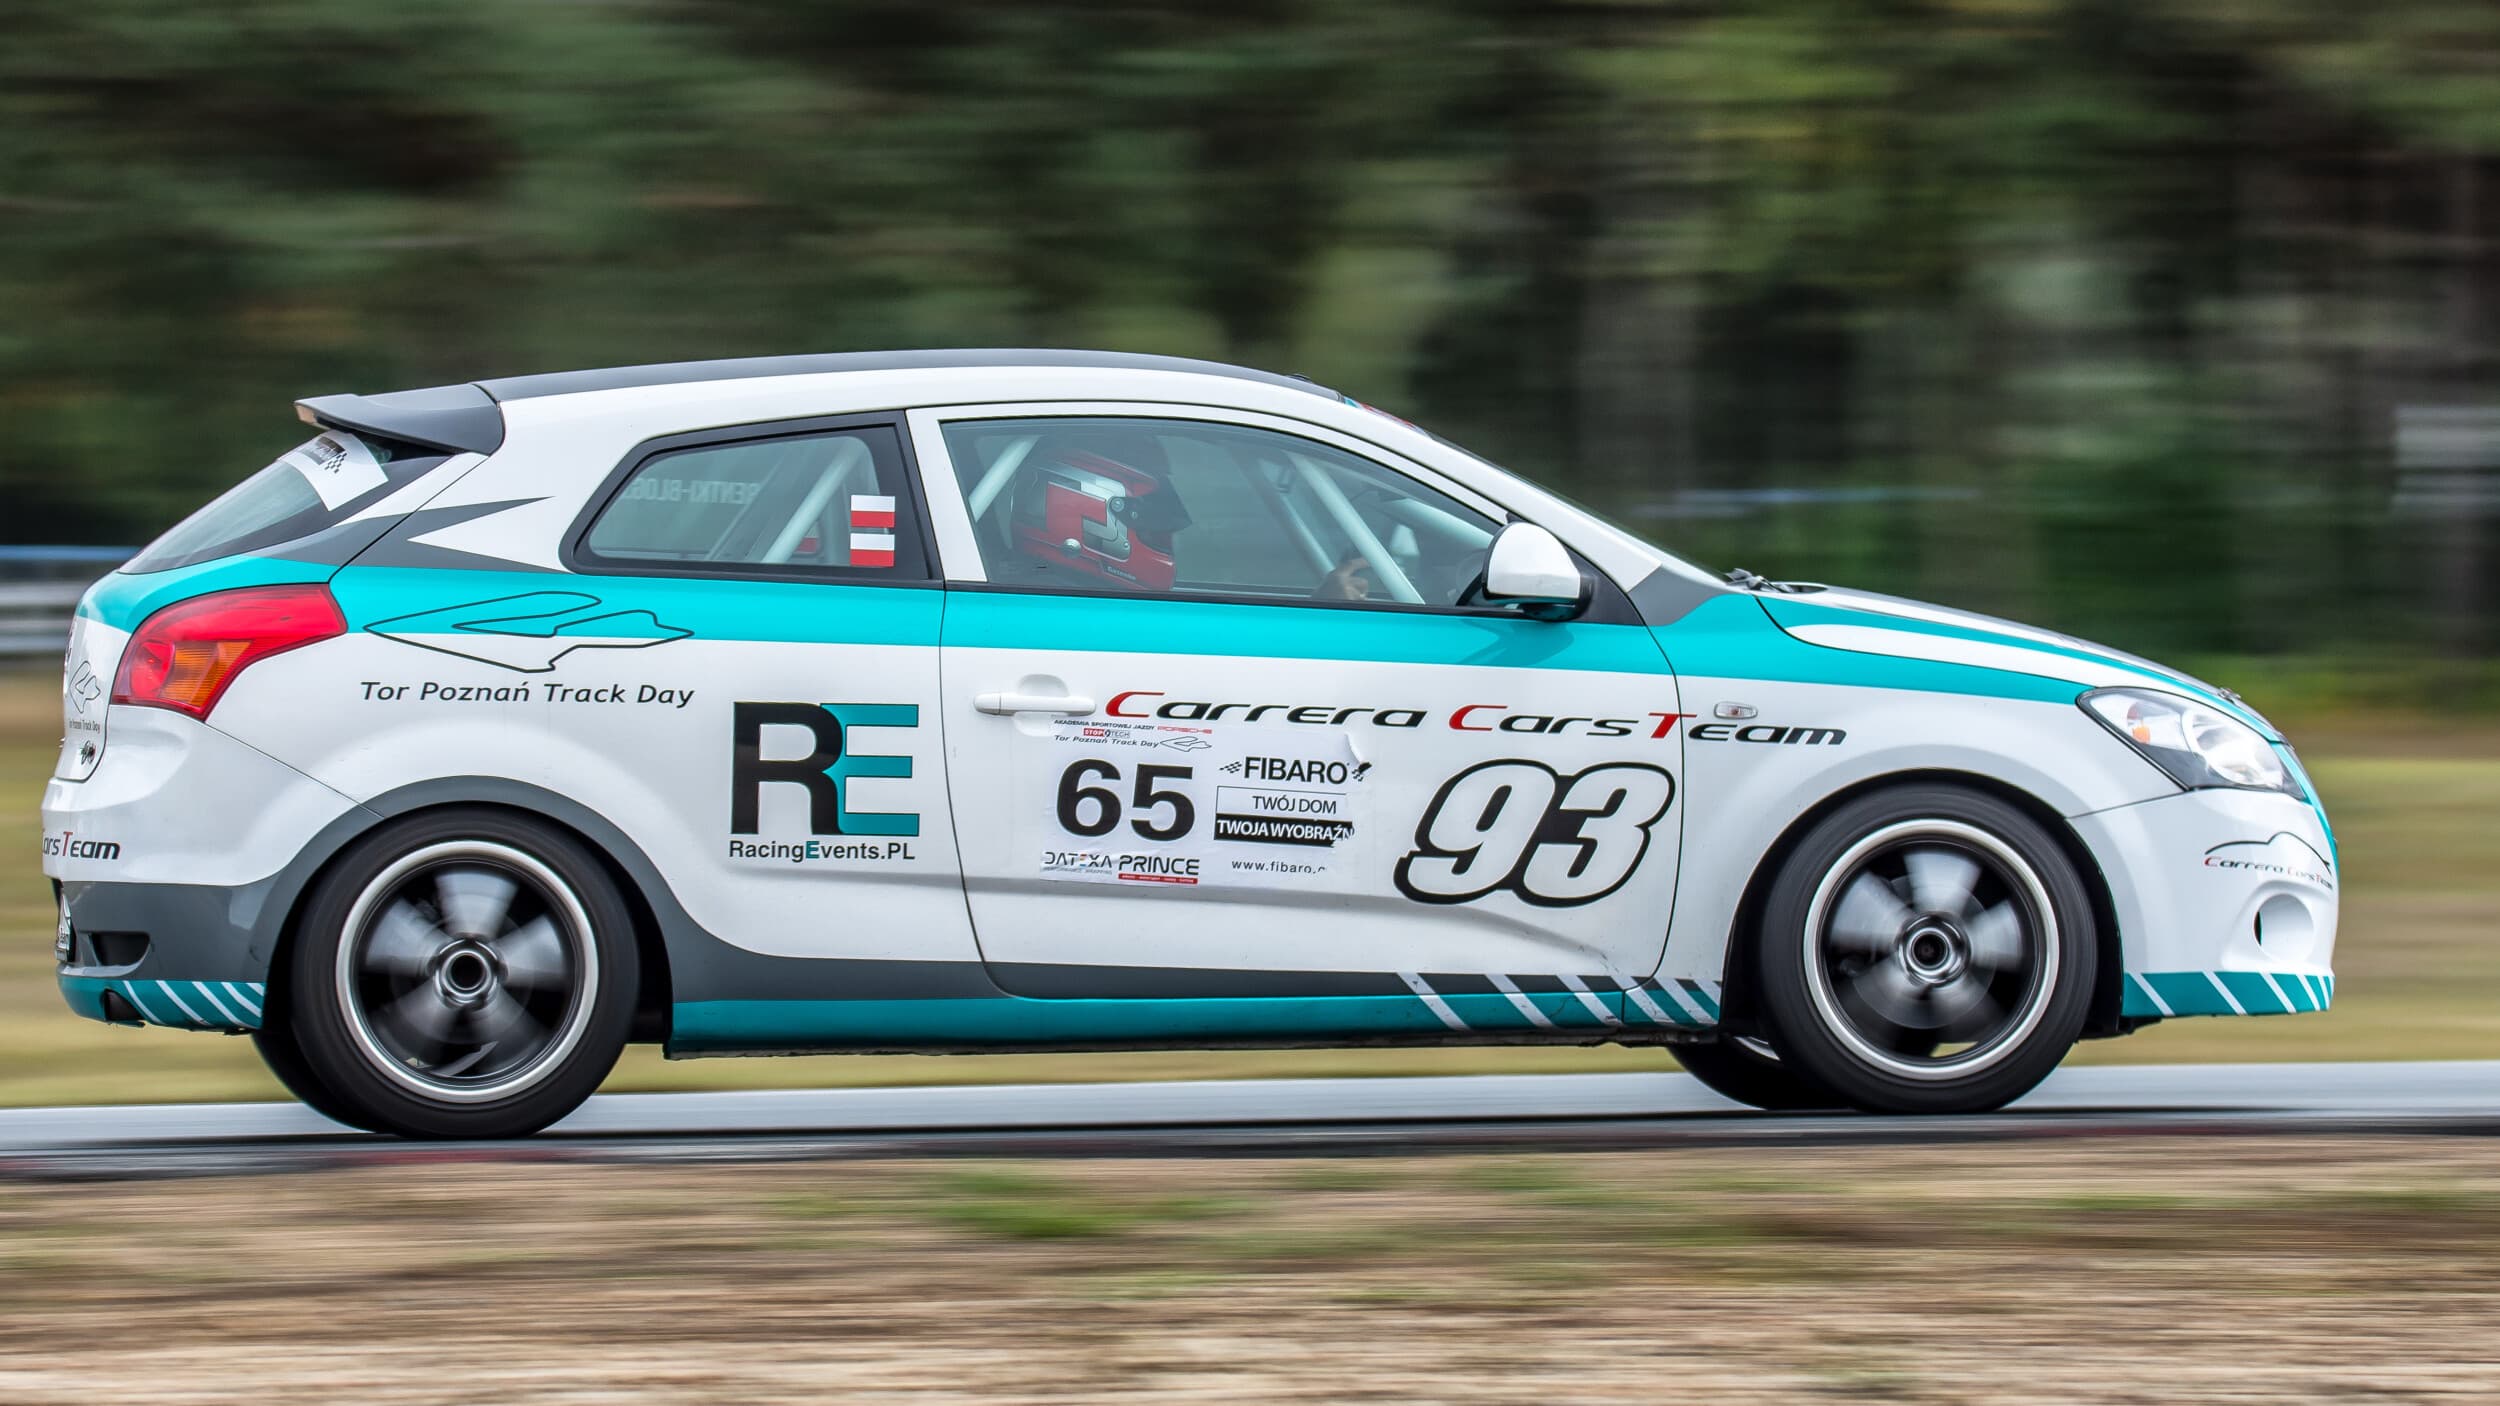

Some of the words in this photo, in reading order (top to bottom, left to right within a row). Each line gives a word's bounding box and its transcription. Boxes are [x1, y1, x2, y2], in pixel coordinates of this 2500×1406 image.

[360, 681, 410, 701] Tor
[419, 681, 530, 702] Poznań
[543, 683, 626, 703] Track
[636, 684, 696, 708] Day
[1105, 690, 1429, 729] Carrera
[1053, 719, 1090, 727] AKADEMIA
[1091, 721, 1132, 729] SPORTOWEJ
[1054, 734, 1070, 742] Tor
[1073, 735, 1108, 744] Poznań
[1111, 738, 1138, 747] Track
[1140, 740, 1160, 749] Day
[730, 701, 920, 837] RE
[1244, 756, 1349, 785] FIBARO
[1057, 758, 1196, 842] 65
[1252, 794, 1296, 812] TWÓJ
[1299, 798, 1338, 815] DOM
[1217, 819, 1269, 837] TWOJA
[1393, 758, 1676, 908] 93
[42, 828, 121, 860] arsTeam
[728, 840, 916, 863] RacingEvents.PL
[1118, 854, 1200, 876] PRINCE
